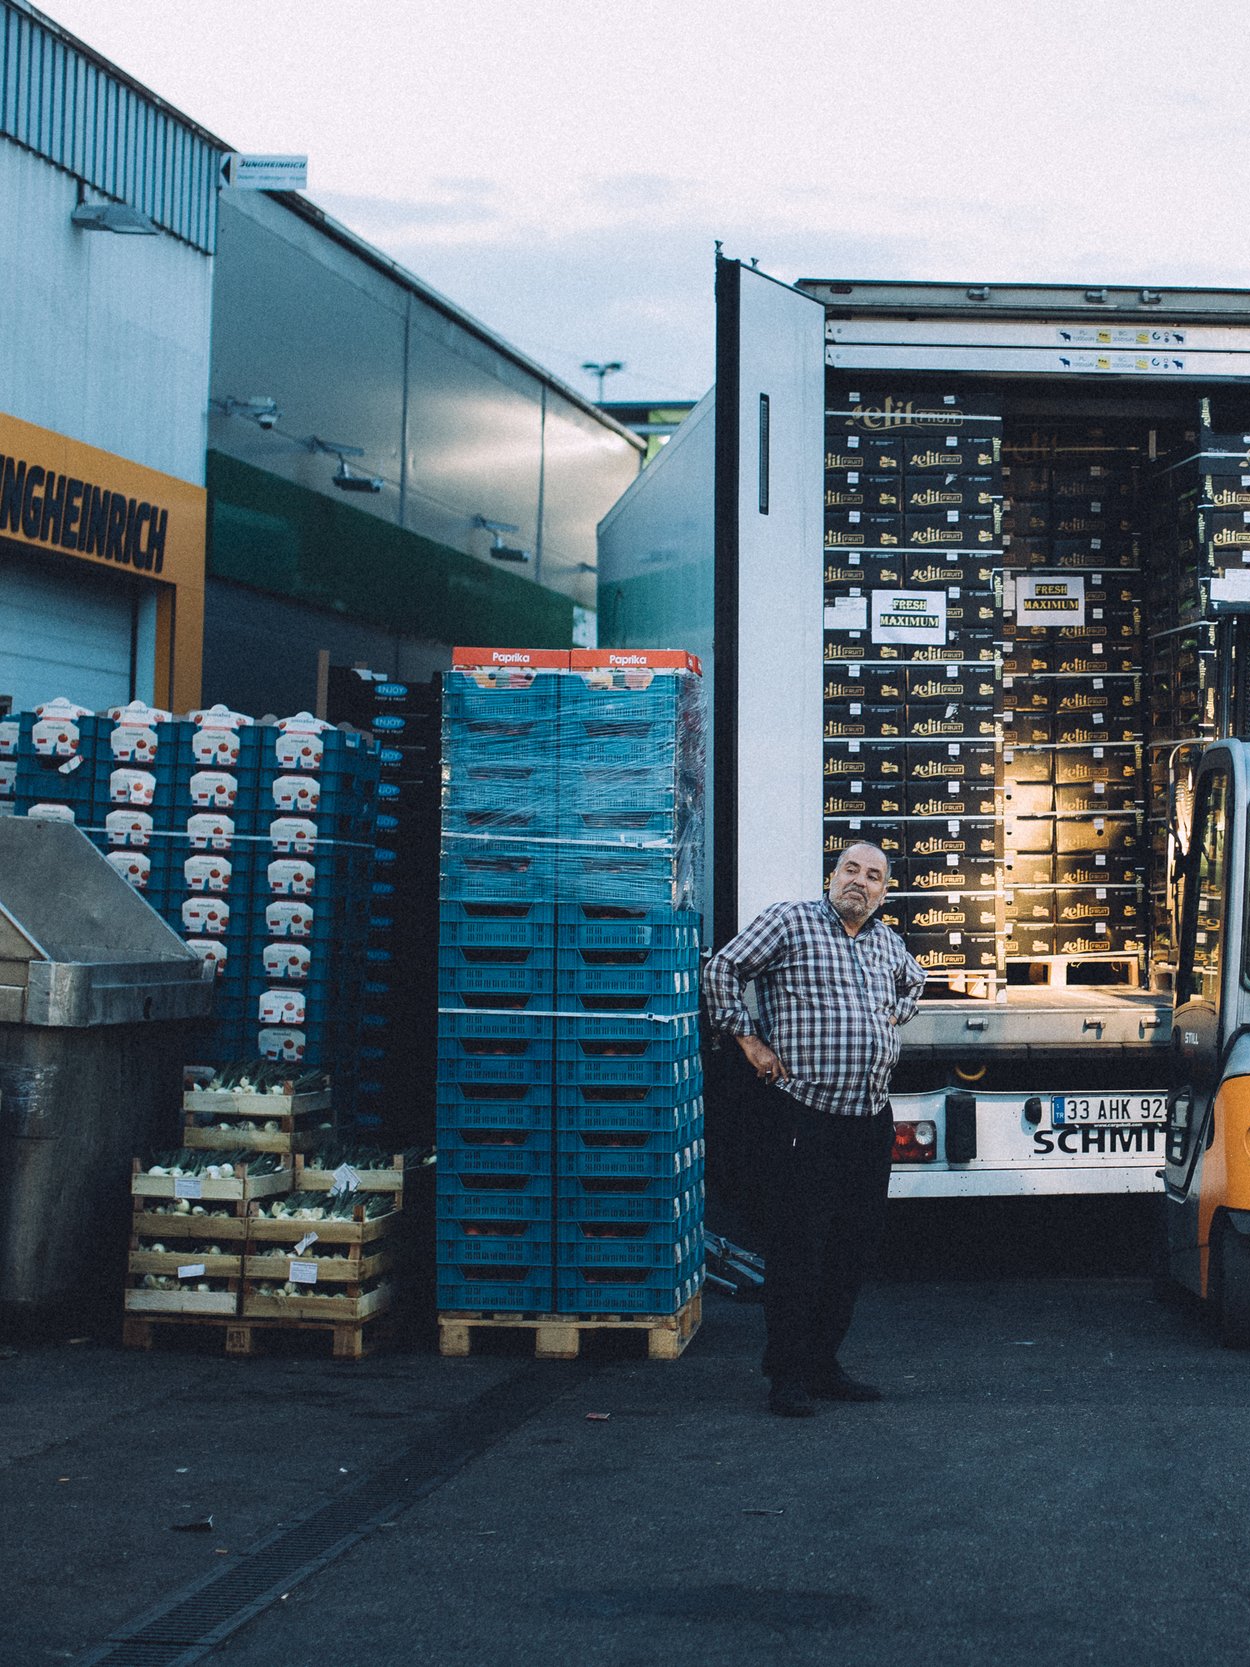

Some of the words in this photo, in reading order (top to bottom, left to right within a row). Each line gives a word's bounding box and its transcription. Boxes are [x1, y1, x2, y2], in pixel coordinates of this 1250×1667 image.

[1035, 584, 1067, 596] FRESH
[893, 600, 927, 610] FRESH
[1024, 599, 1079, 611] MAXIMUM
[880, 615, 939, 627] MAXIMUM
[492, 651, 530, 664] Paprika
[609, 653, 647, 667] Paprika
[378, 686, 404, 694] ENJOY
[376, 718, 401, 727] ENJOY
[1184, 1032, 1198, 1044] STILL
[1067, 1100, 1090, 1120] 33
[1098, 1099, 1131, 1120] AHK
[1140, 1099, 1168, 1119] 92
[1033, 1129, 1167, 1154] SCHMI
